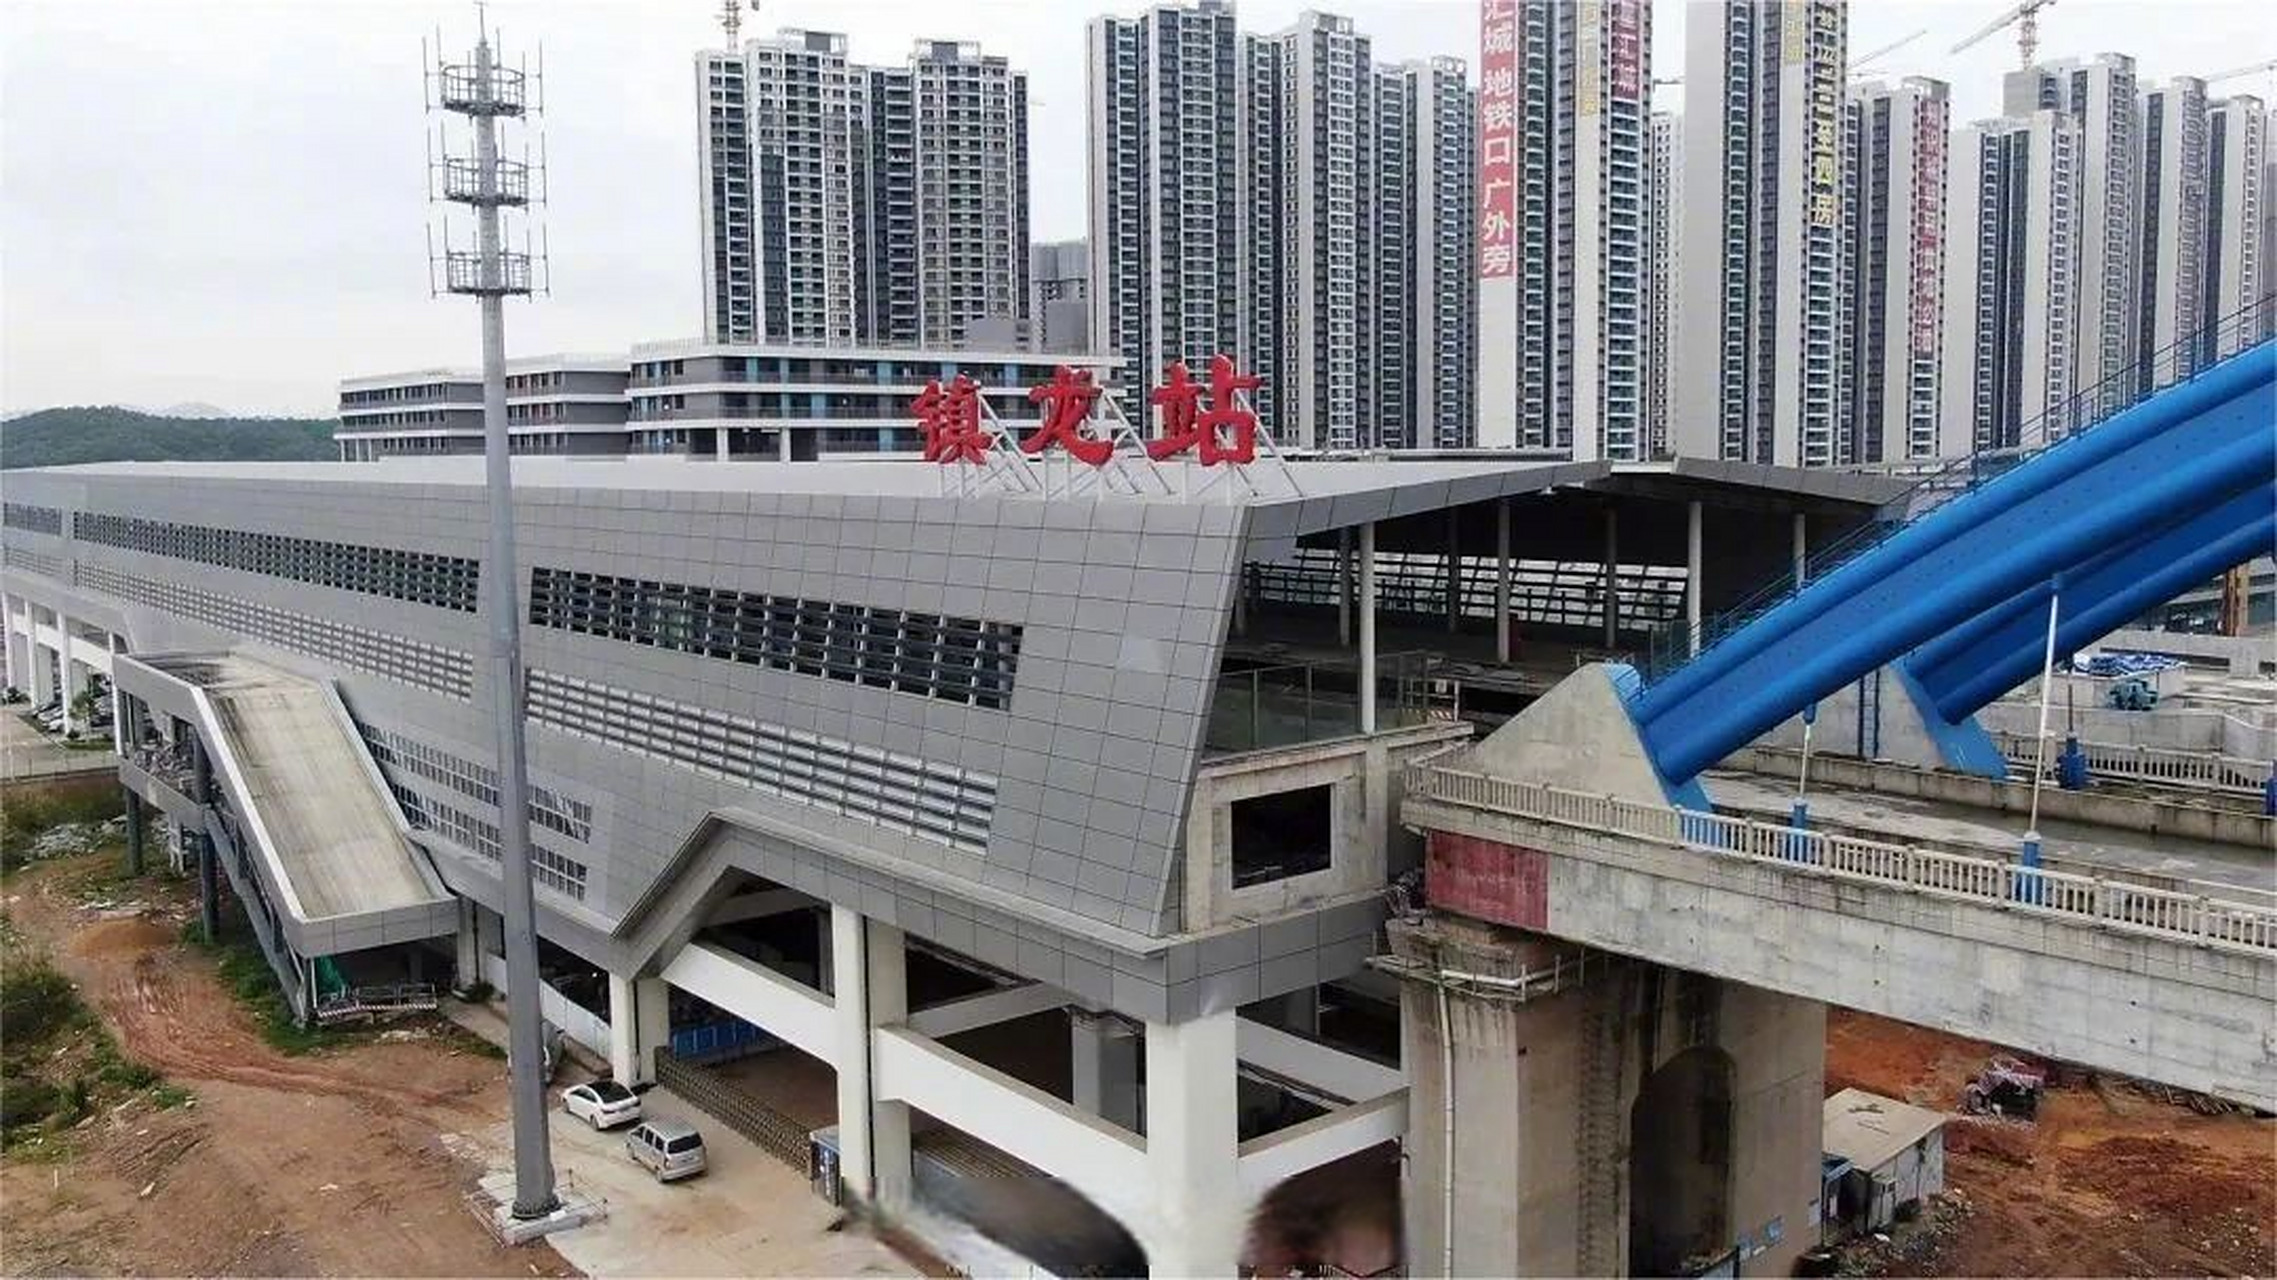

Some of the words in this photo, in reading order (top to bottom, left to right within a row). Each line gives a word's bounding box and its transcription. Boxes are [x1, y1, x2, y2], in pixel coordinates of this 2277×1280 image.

[1484, 67, 1513, 165] 地铁口
[1482, 177, 1511, 275] 广外旁
[910, 353, 1263, 468] 镇龙站
